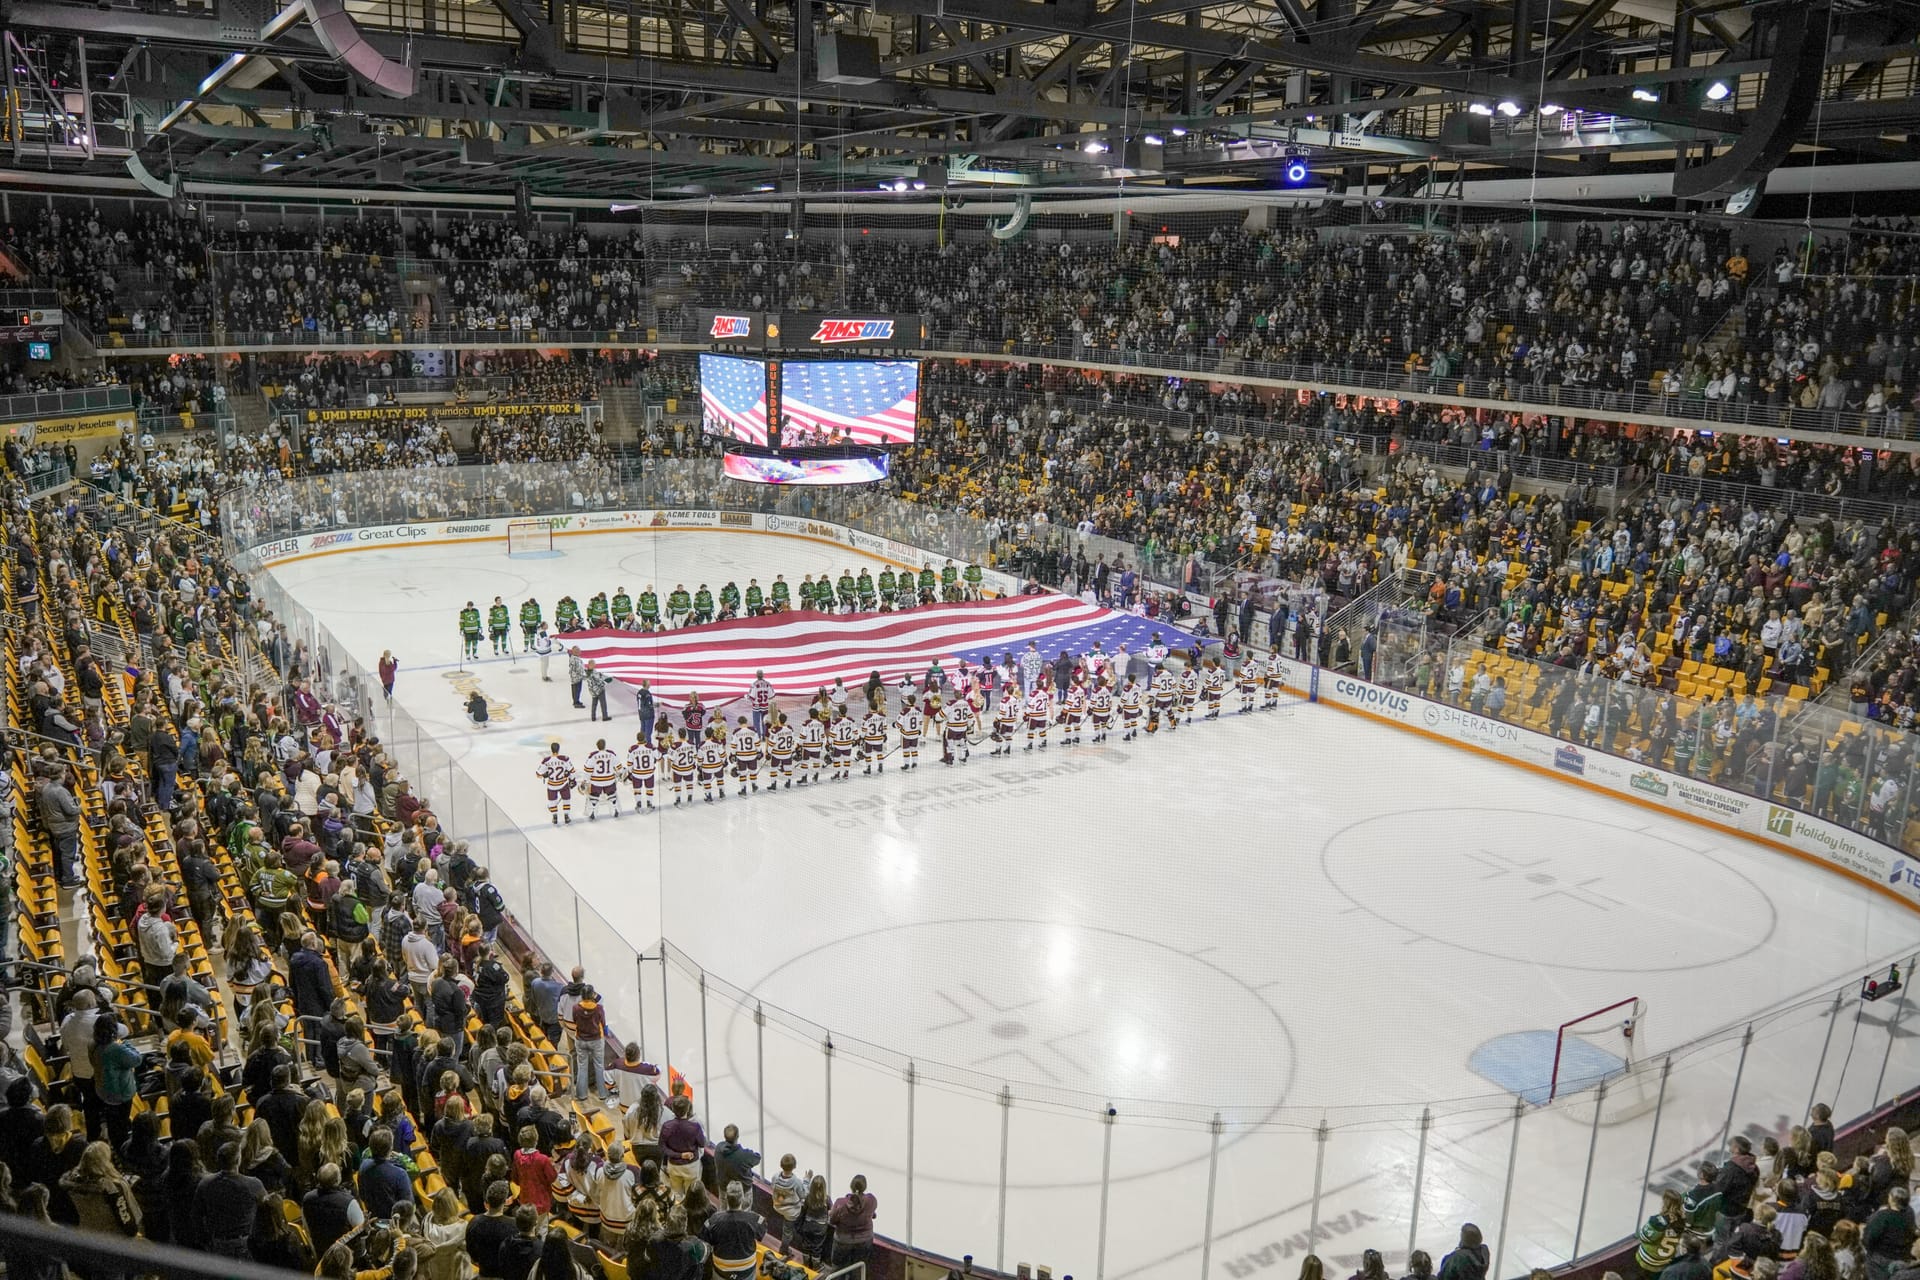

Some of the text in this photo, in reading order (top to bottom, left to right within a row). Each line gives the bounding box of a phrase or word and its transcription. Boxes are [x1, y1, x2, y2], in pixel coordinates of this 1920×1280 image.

[711, 316, 750, 338] AMSOIL
[812, 320, 893, 342] AMSOIL
[769, 363, 777, 434] BULLDOGS
[322, 407, 427, 420] UMD PENALTY BOX
[432, 406, 469, 417] @umdpb
[473, 405, 496, 416] UMD
[549, 403, 570, 414] BOX
[36, 419, 116, 434] Security Jewelers
[666, 511, 716, 519] ACME TOOLS
[721, 512, 751, 525] JAMAR
[446, 524, 490, 534] ENBRIDGE
[780, 519, 797, 529] HUNT
[310, 531, 353, 548] AMSOIL
[358, 526, 427, 541] Great Clips
[255, 538, 299, 560] LOFFLER
[1160, 679, 1173, 691] 35
[1212, 675, 1224, 687] 20
[757, 689, 769, 703] 55
[1097, 694, 1110, 708] 33
[1336, 678, 1409, 713] cenovus
[1036, 699, 1047, 712] 27
[954, 707, 968, 721] 36
[868, 723, 884, 736] 34
[909, 716, 917, 730] 8
[1442, 708, 1519, 742] SHERATON
[810, 728, 821, 742] 11
[838, 726, 852, 741] 12
[738, 736, 753, 751] 19
[777, 735, 793, 750] 28
[635, 755, 650, 769] 18
[678, 750, 694, 766] 26
[706, 750, 716, 763] 6
[547, 766, 564, 781] 22
[596, 760, 611, 774] 31
[991, 761, 1090, 785] Bank
[1631, 776, 1667, 794] Green Mill
[1672, 781, 1713, 799] FULL-MENU
[1713, 793, 1750, 809] DELIVERY
[1678, 790, 1692, 800] DAILY
[1693, 795, 1717, 807] TAKE-OUT
[1717, 801, 1741, 815] SPECIALS
[1795, 821, 1886, 869] Holiday Inn & Suites
